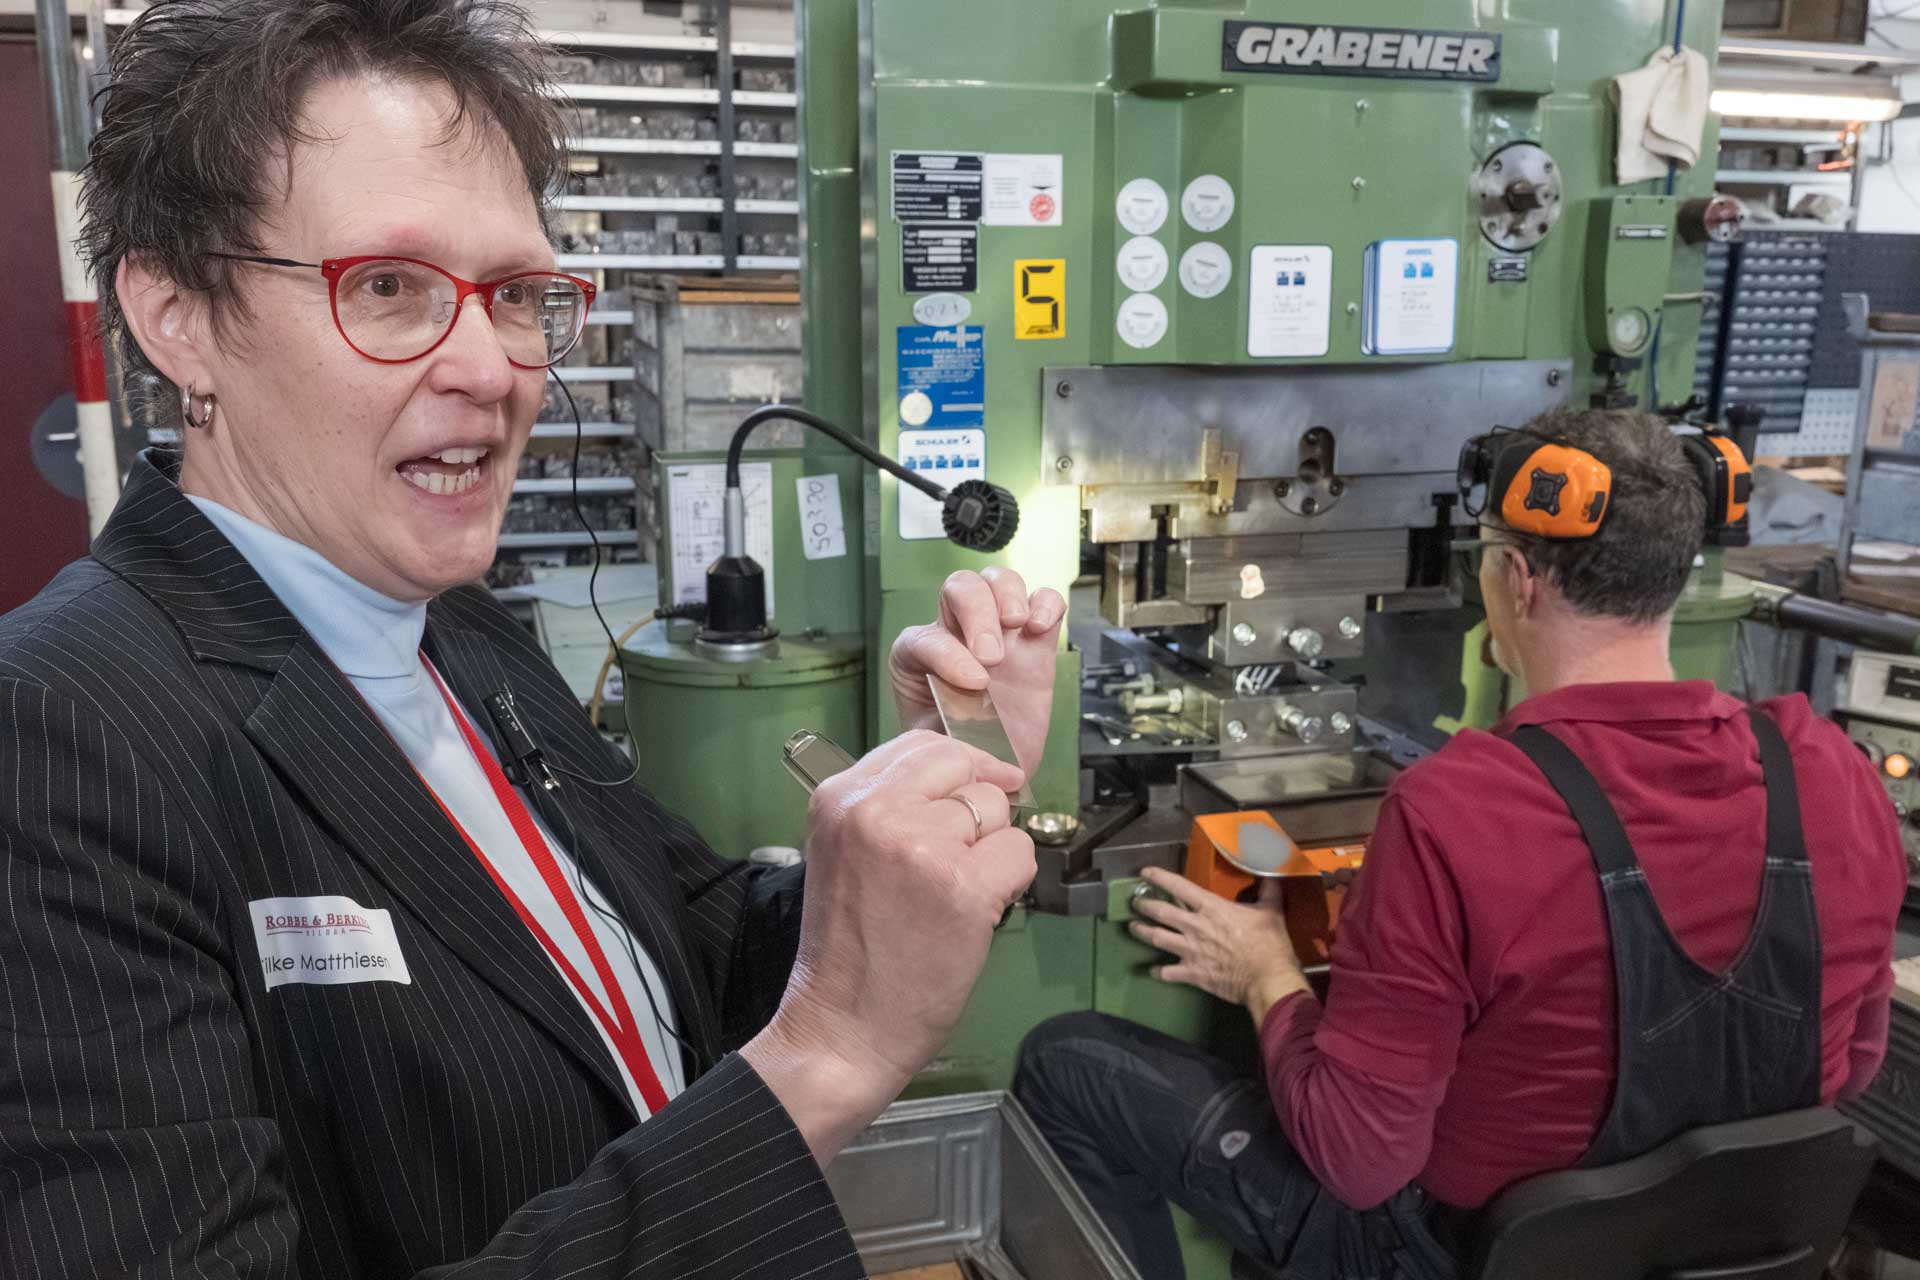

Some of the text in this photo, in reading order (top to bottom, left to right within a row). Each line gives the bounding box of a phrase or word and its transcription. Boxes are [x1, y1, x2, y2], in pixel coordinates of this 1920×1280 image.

[1236, 27, 1496, 73] GRÄBENER
[1022, 265, 1059, 335] 5
[265, 915, 308, 928] ROBBE
[312, 914, 322, 926] &
[261, 956, 295, 975] ilke
